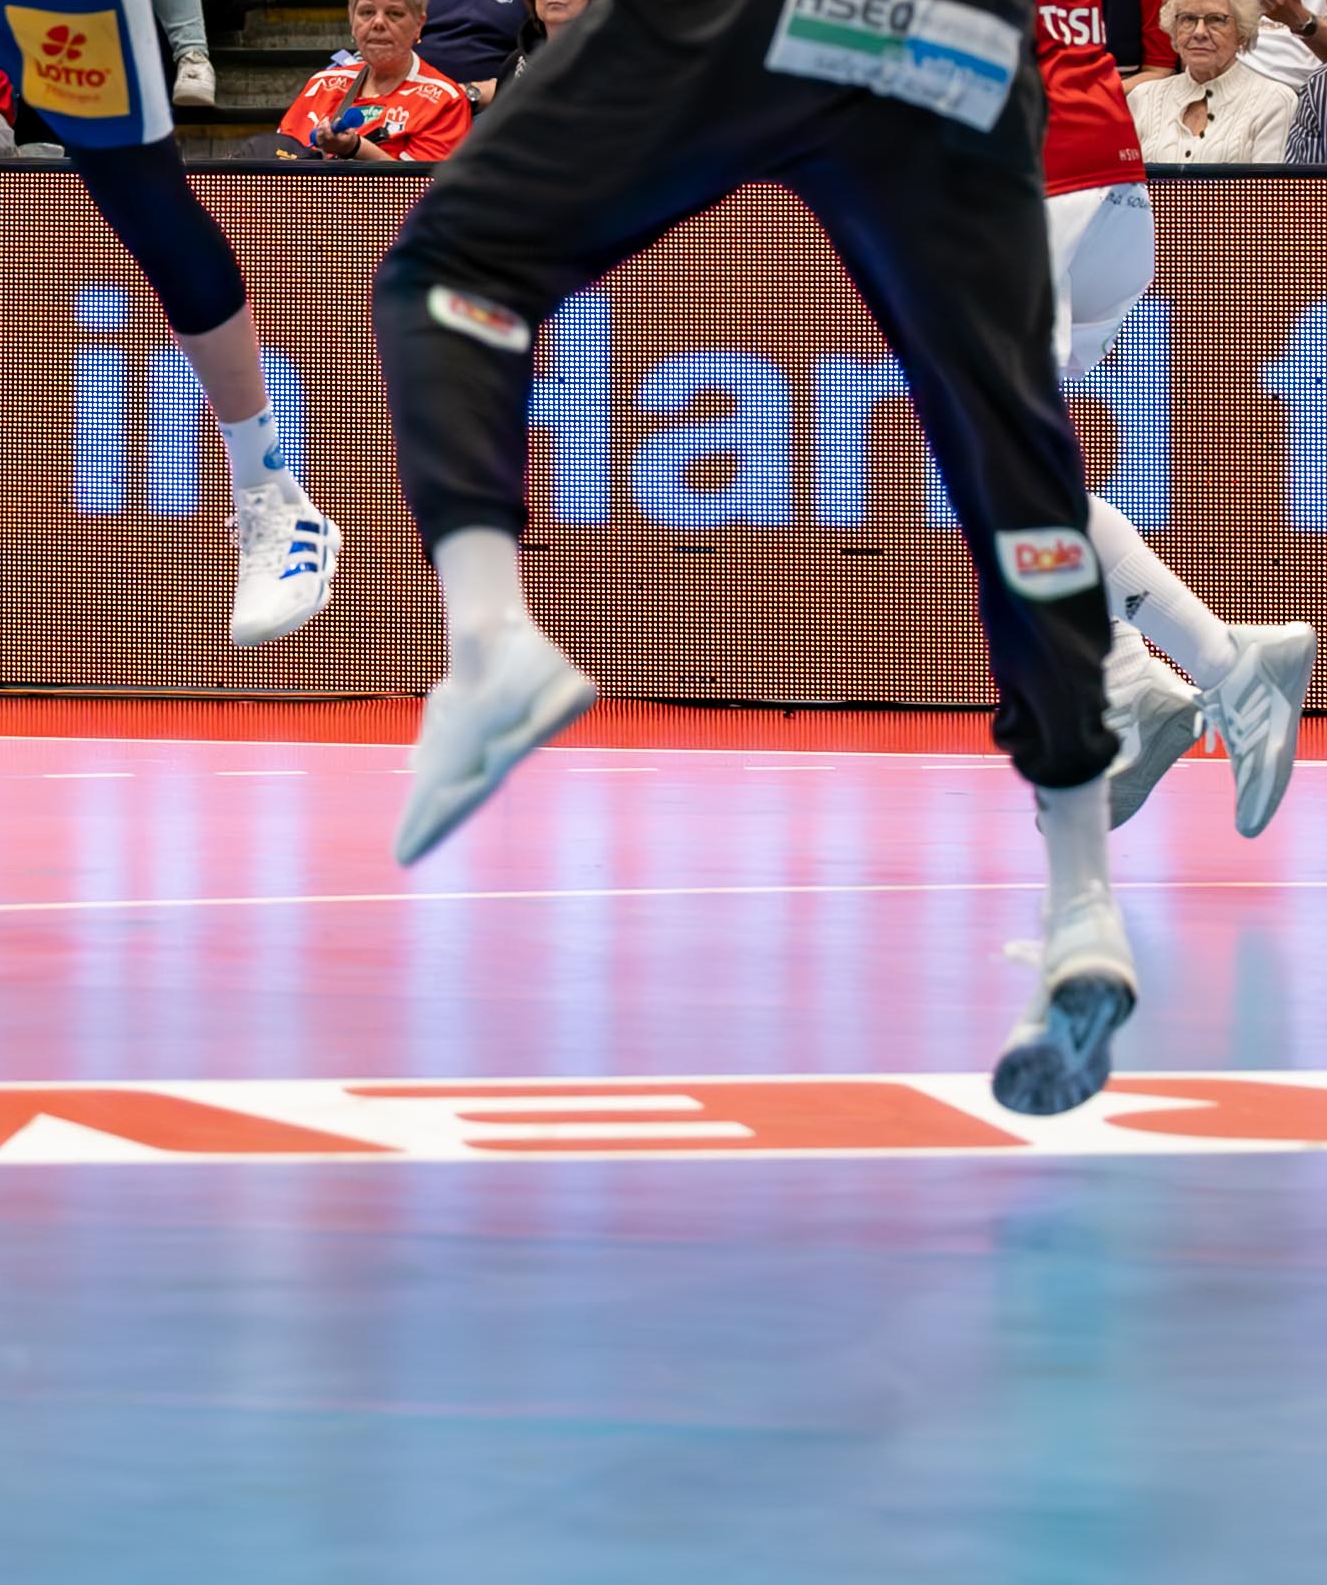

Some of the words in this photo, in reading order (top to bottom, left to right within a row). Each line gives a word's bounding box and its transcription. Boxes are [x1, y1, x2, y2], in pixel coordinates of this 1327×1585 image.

[34, 58, 106, 88] LOTTO
[73, 283, 307, 517] in
[1015, 540, 1083, 572] Dole
